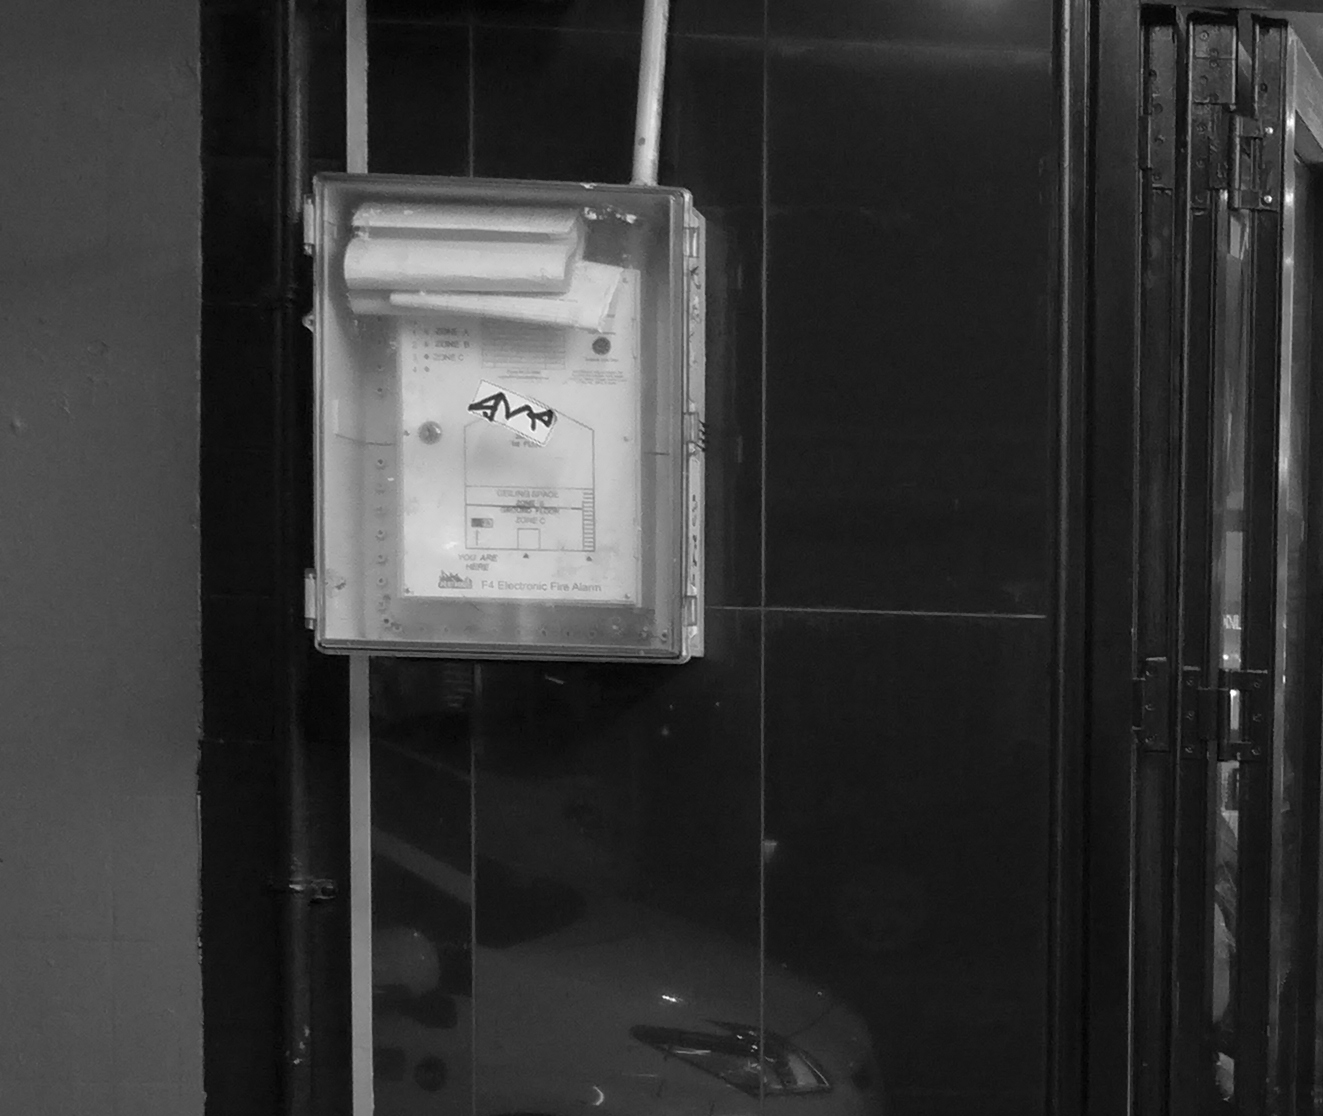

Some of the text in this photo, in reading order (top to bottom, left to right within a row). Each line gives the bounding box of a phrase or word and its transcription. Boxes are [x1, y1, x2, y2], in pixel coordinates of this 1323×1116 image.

[497, 581, 549, 592] Electronic
[550, 582, 570, 592] Fire
[571, 582, 602, 593] Alarm
